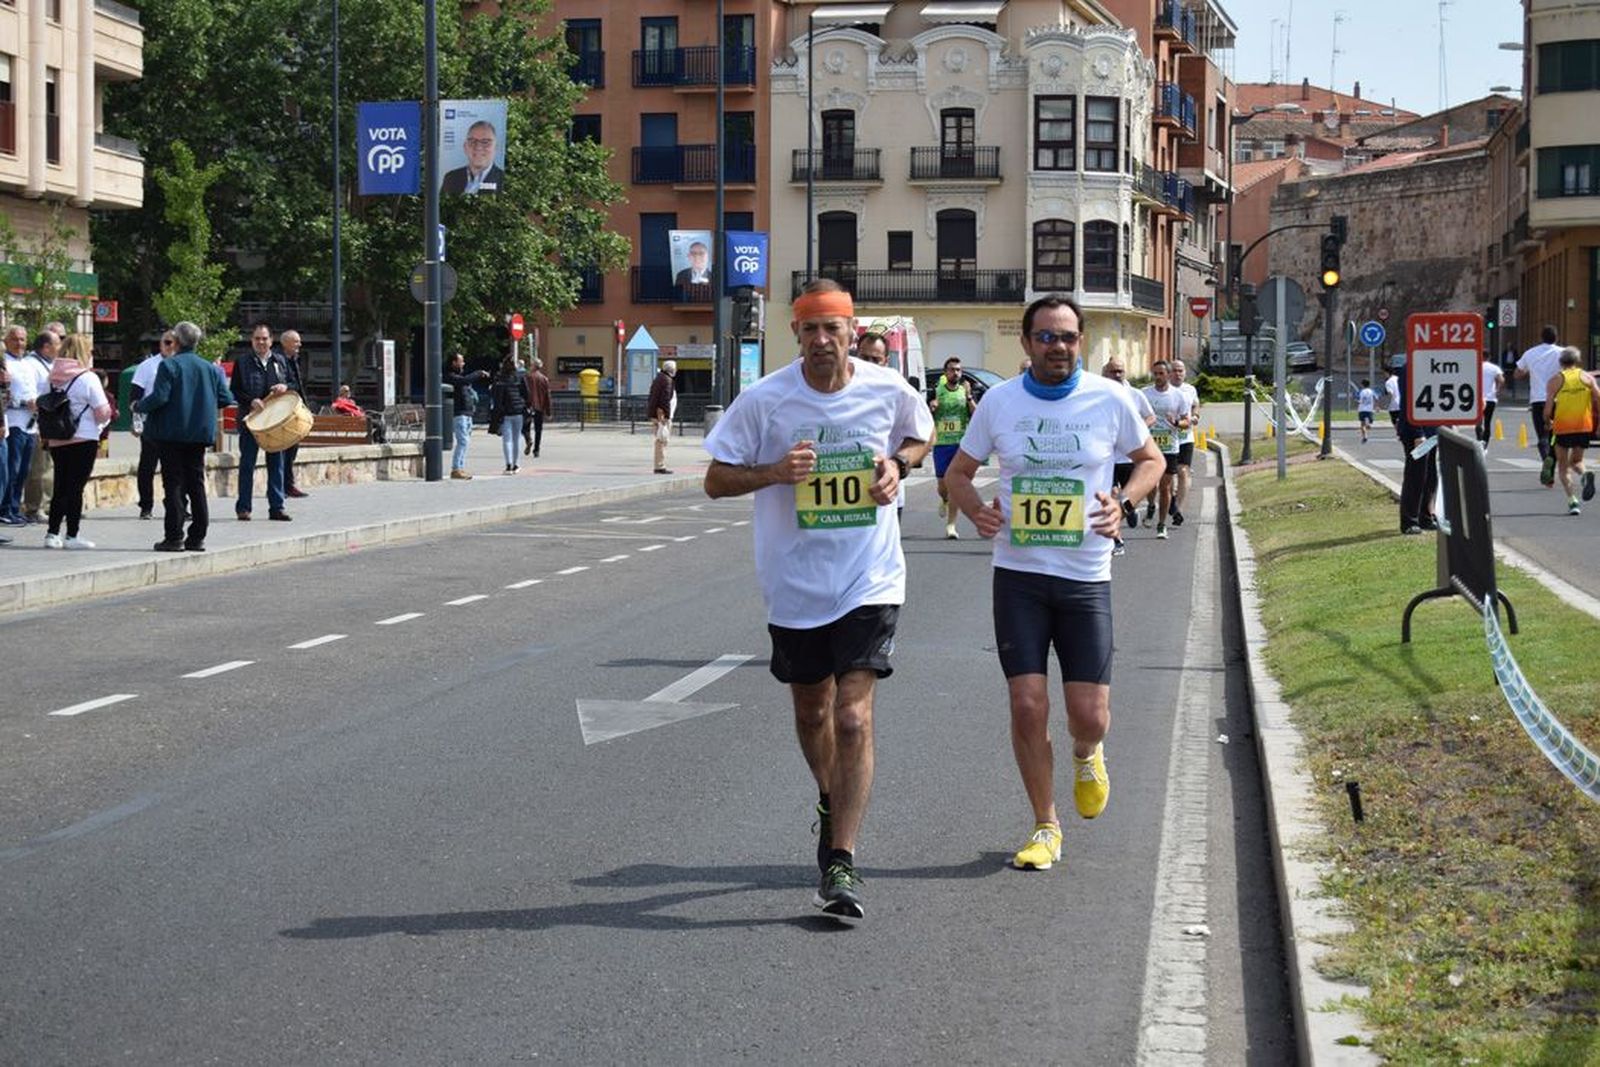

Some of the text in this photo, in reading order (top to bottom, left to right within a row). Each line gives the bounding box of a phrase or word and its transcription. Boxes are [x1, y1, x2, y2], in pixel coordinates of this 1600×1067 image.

[368, 128, 407, 141] VOTA
[734, 246, 760, 254] VOTA
[1414, 323, 1475, 343] N-122
[1430, 358, 1459, 373] km
[1415, 383, 1474, 412] 459
[943, 422, 955, 431] 70
[808, 476, 860, 506] 110
[821, 512, 873, 524] CAJA RURAL
[1019, 498, 1072, 526] 167
[1031, 533, 1079, 543] CAJA RURAL
